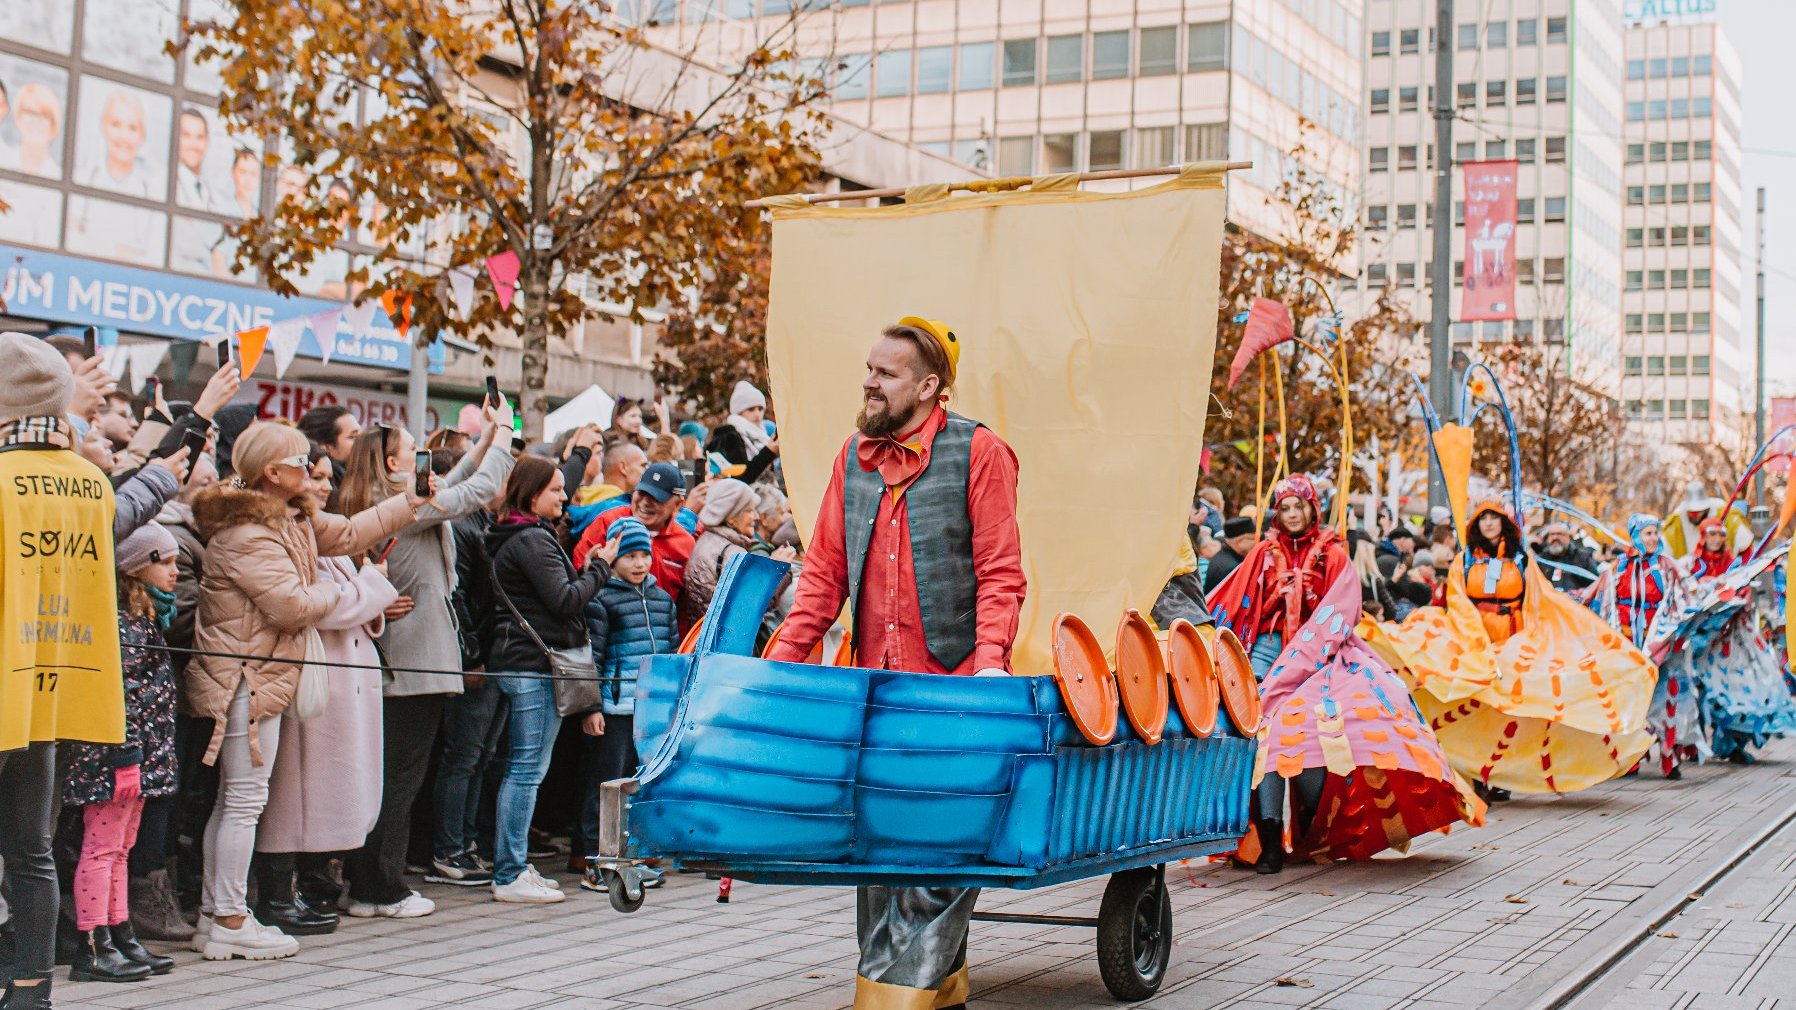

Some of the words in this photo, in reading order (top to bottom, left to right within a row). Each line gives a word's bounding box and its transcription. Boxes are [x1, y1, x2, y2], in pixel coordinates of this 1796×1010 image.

[67, 275, 275, 334] MEDYCZNE
[14, 475, 103, 500] STEWARD
[20, 530, 98, 561] SOWA
[36, 672, 58, 692] 17
